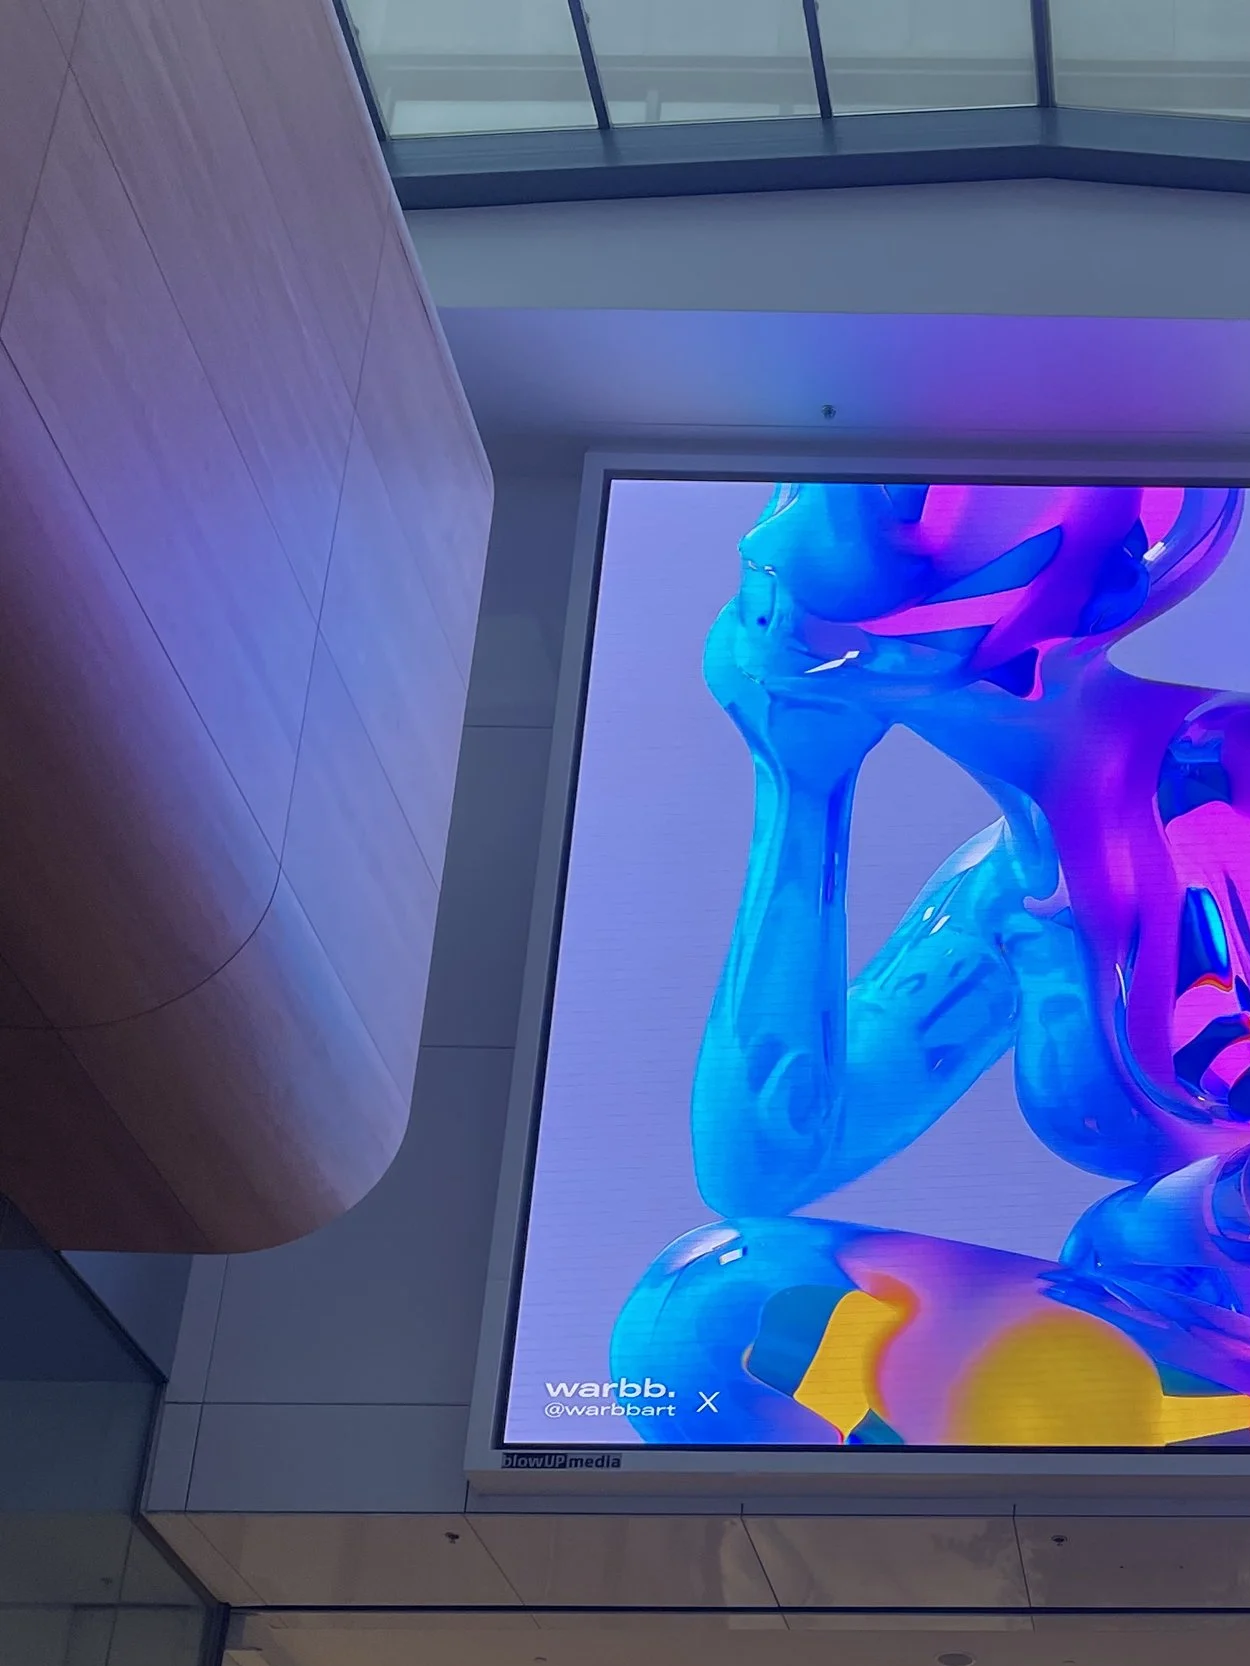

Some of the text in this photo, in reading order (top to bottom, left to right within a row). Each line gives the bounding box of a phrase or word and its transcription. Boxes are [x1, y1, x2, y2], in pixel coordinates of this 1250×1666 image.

[545, 1378, 676, 1398] warbb.
[544, 1402, 676, 1418] @warbbart
[568, 1453, 621, 1469] media
